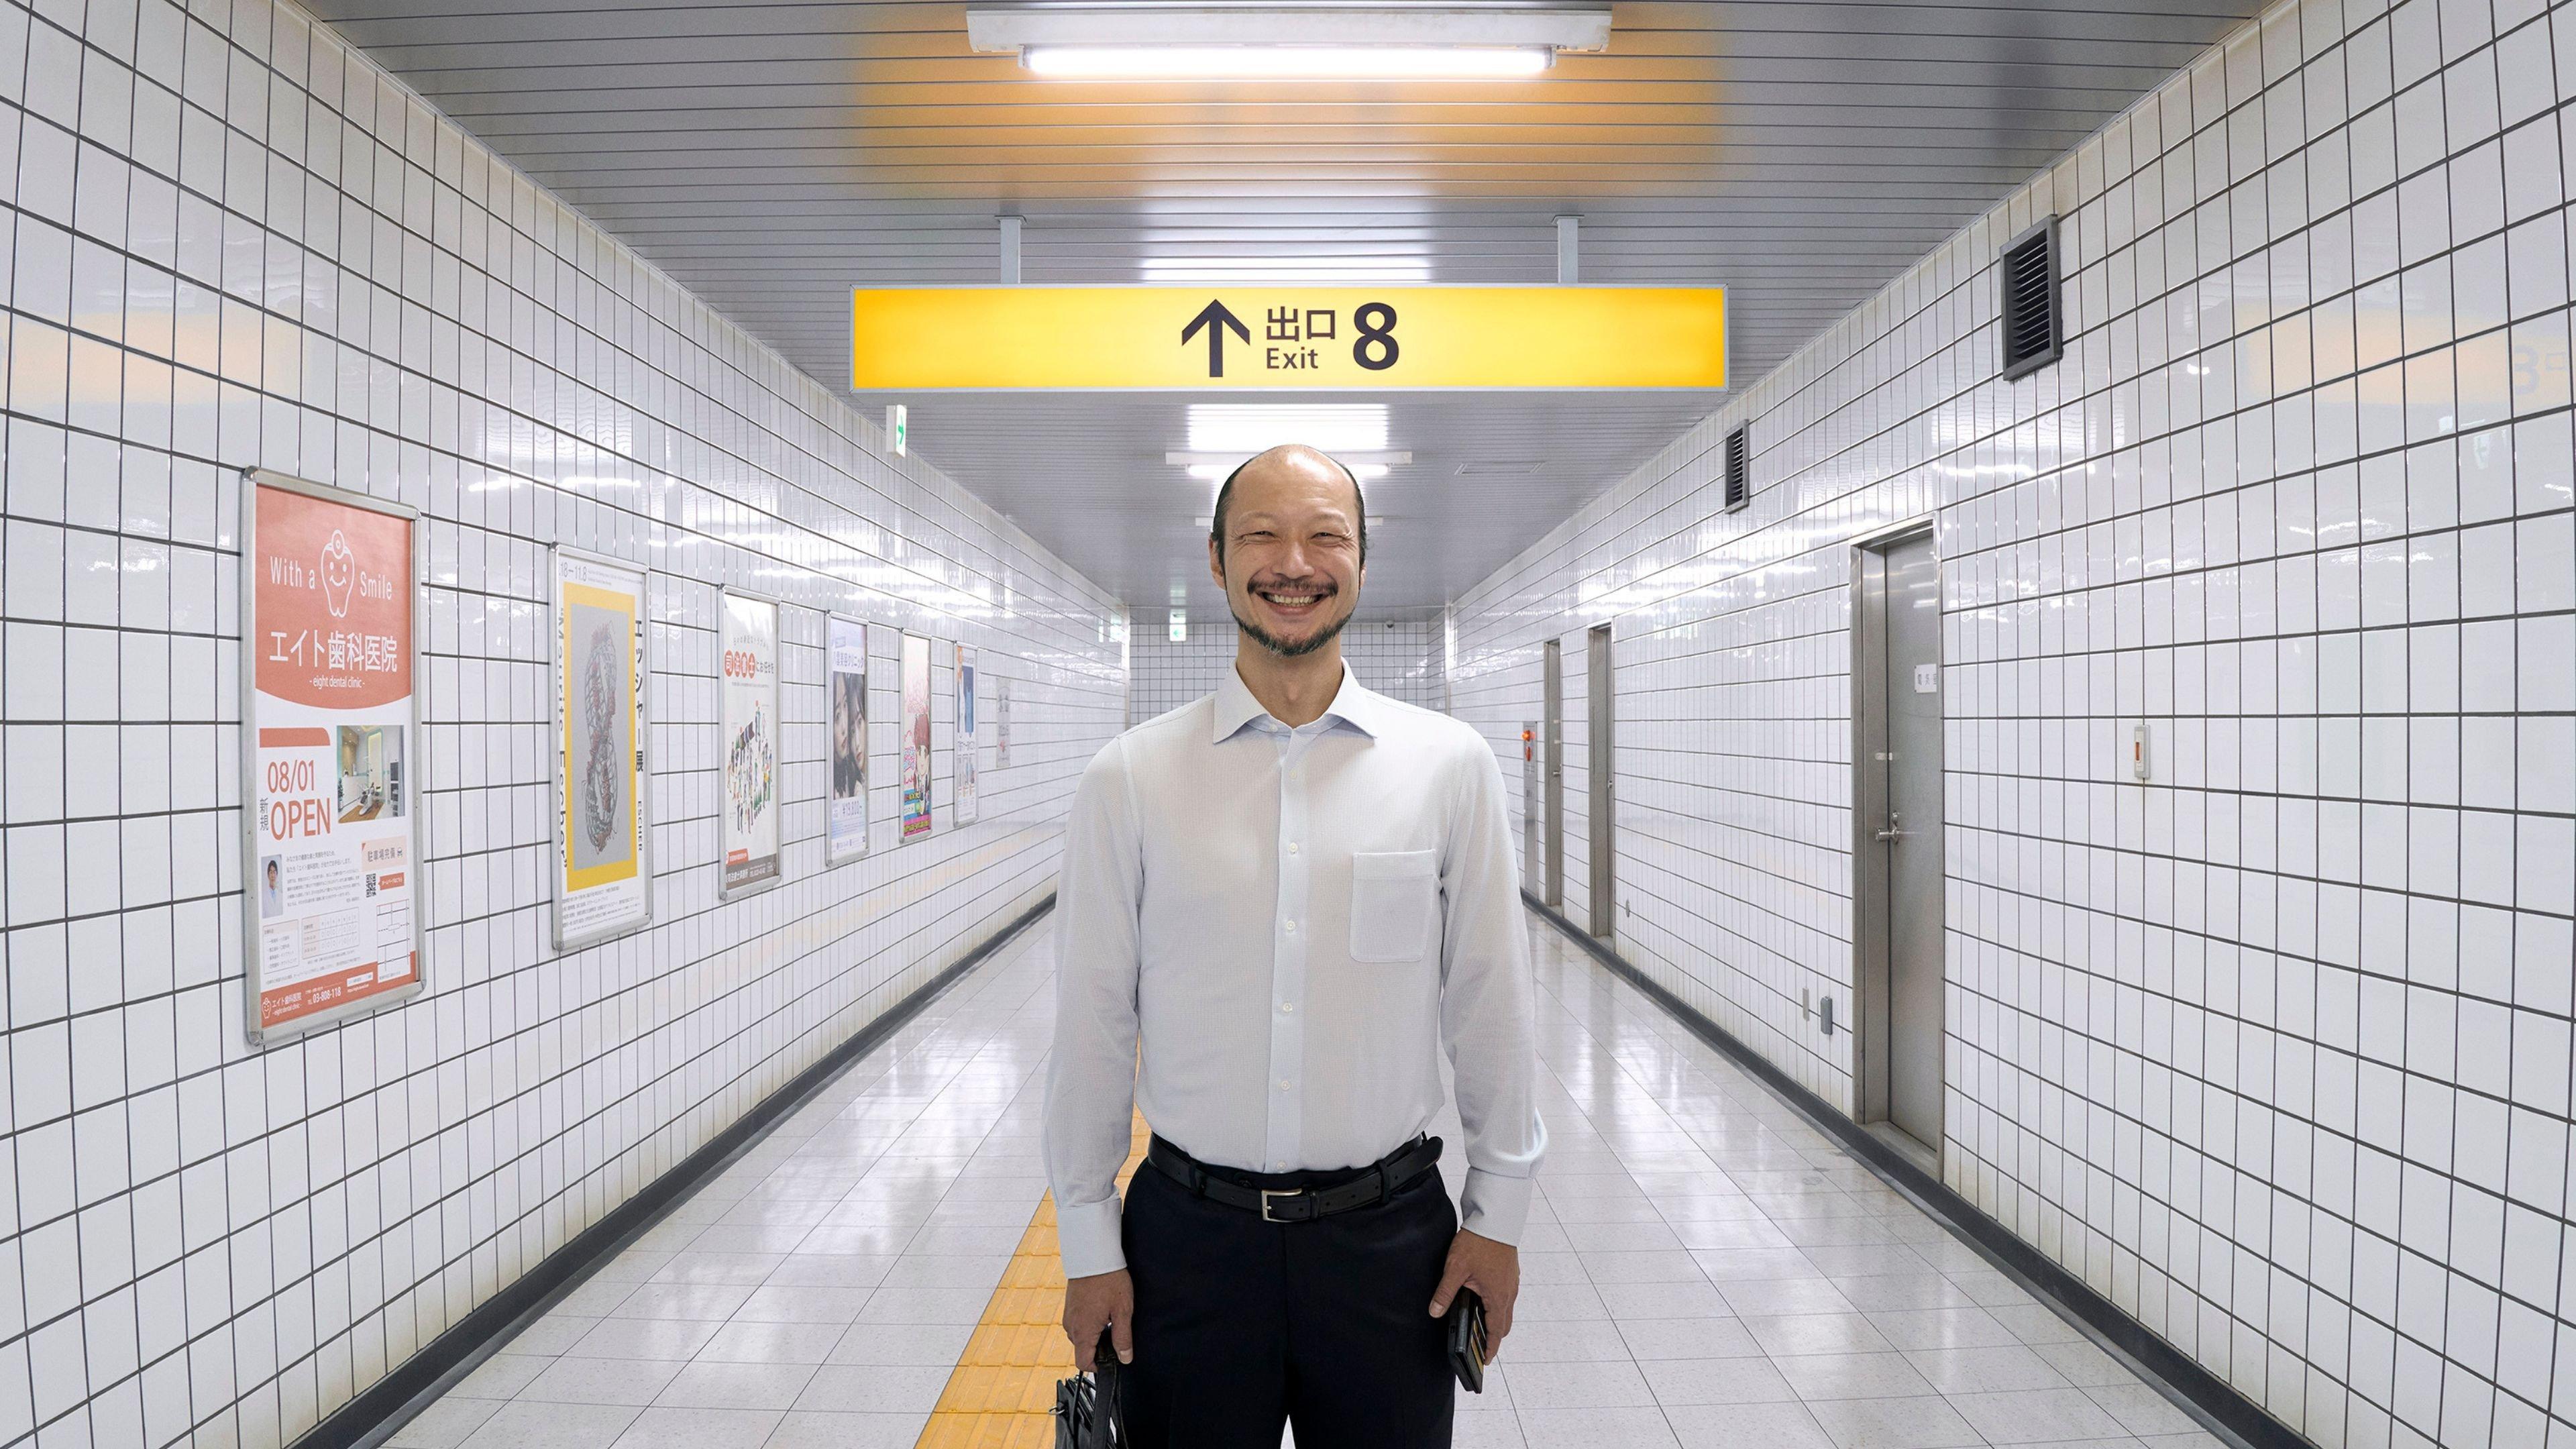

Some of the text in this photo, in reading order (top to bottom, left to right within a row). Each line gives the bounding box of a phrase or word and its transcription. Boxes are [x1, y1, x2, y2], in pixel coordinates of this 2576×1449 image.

[1267, 306, 1336, 341] 出口
[1353, 302, 1399, 370] 8
[1267, 347, 1319, 370] Exit
[270, 556, 392, 600] With a Smile
[270, 630, 397, 672] エイト歯科医院
[329, 674, 347, 688] dental
[635, 620, 643, 772] エッシャー展
[268, 759, 314, 794] 08/01
[271, 798, 331, 841] OPEN
